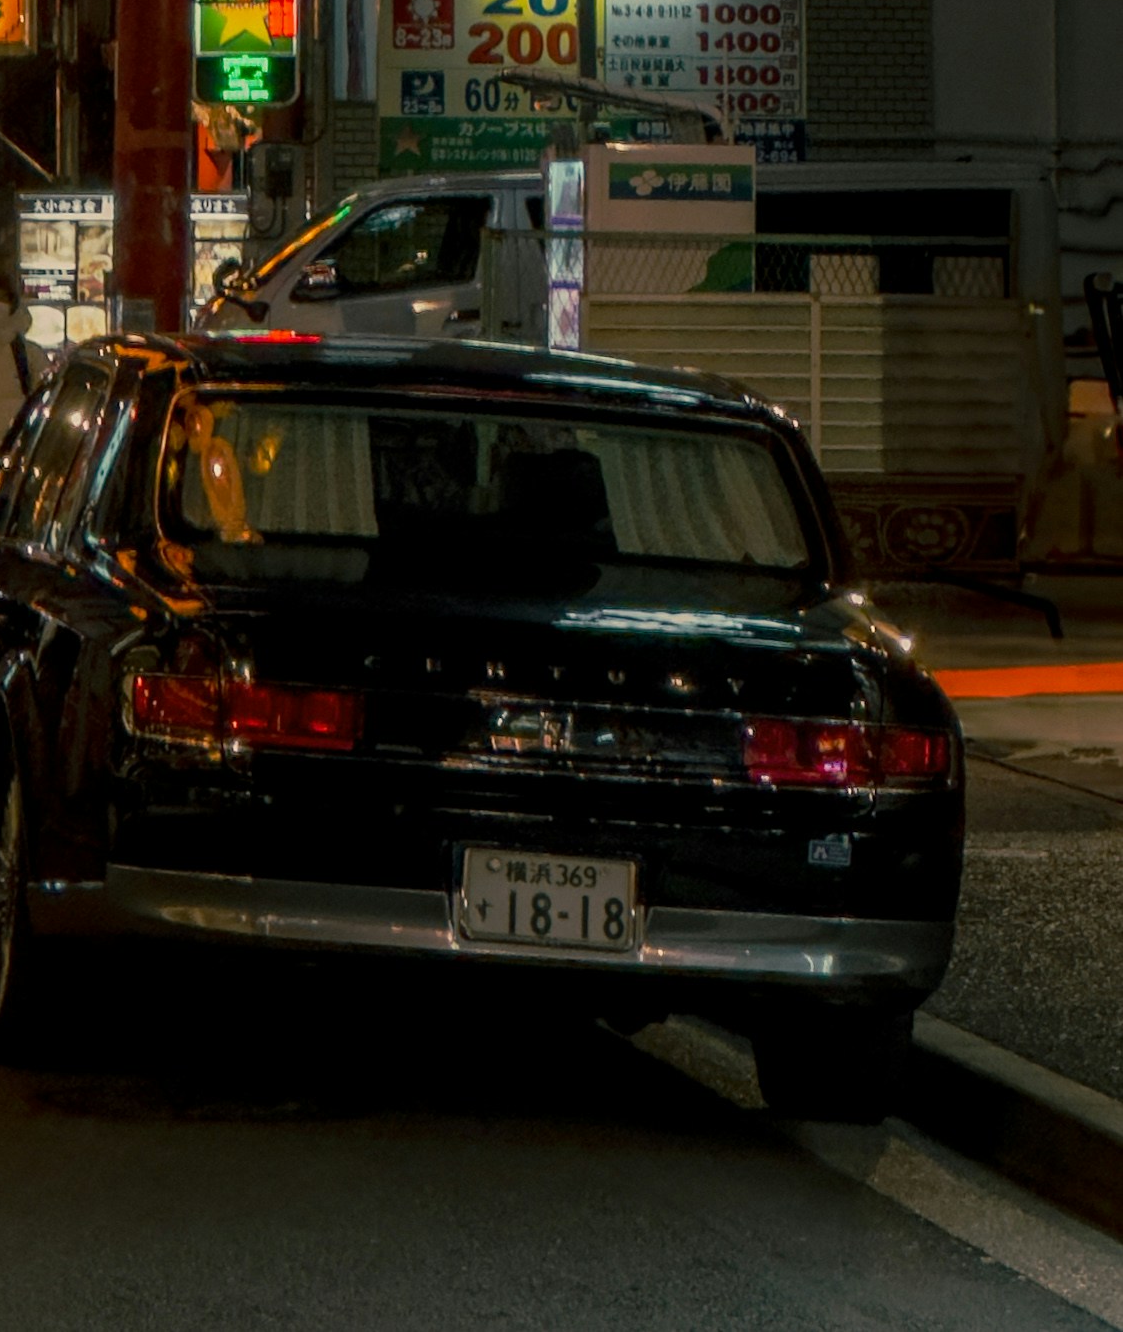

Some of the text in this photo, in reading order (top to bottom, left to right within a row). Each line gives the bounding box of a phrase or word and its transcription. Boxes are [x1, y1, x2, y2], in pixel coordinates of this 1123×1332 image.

[467, 21, 578, 65] 200
[505, 859, 599, 889] 横浜 369
[508, 889, 625, 940] 18-18
